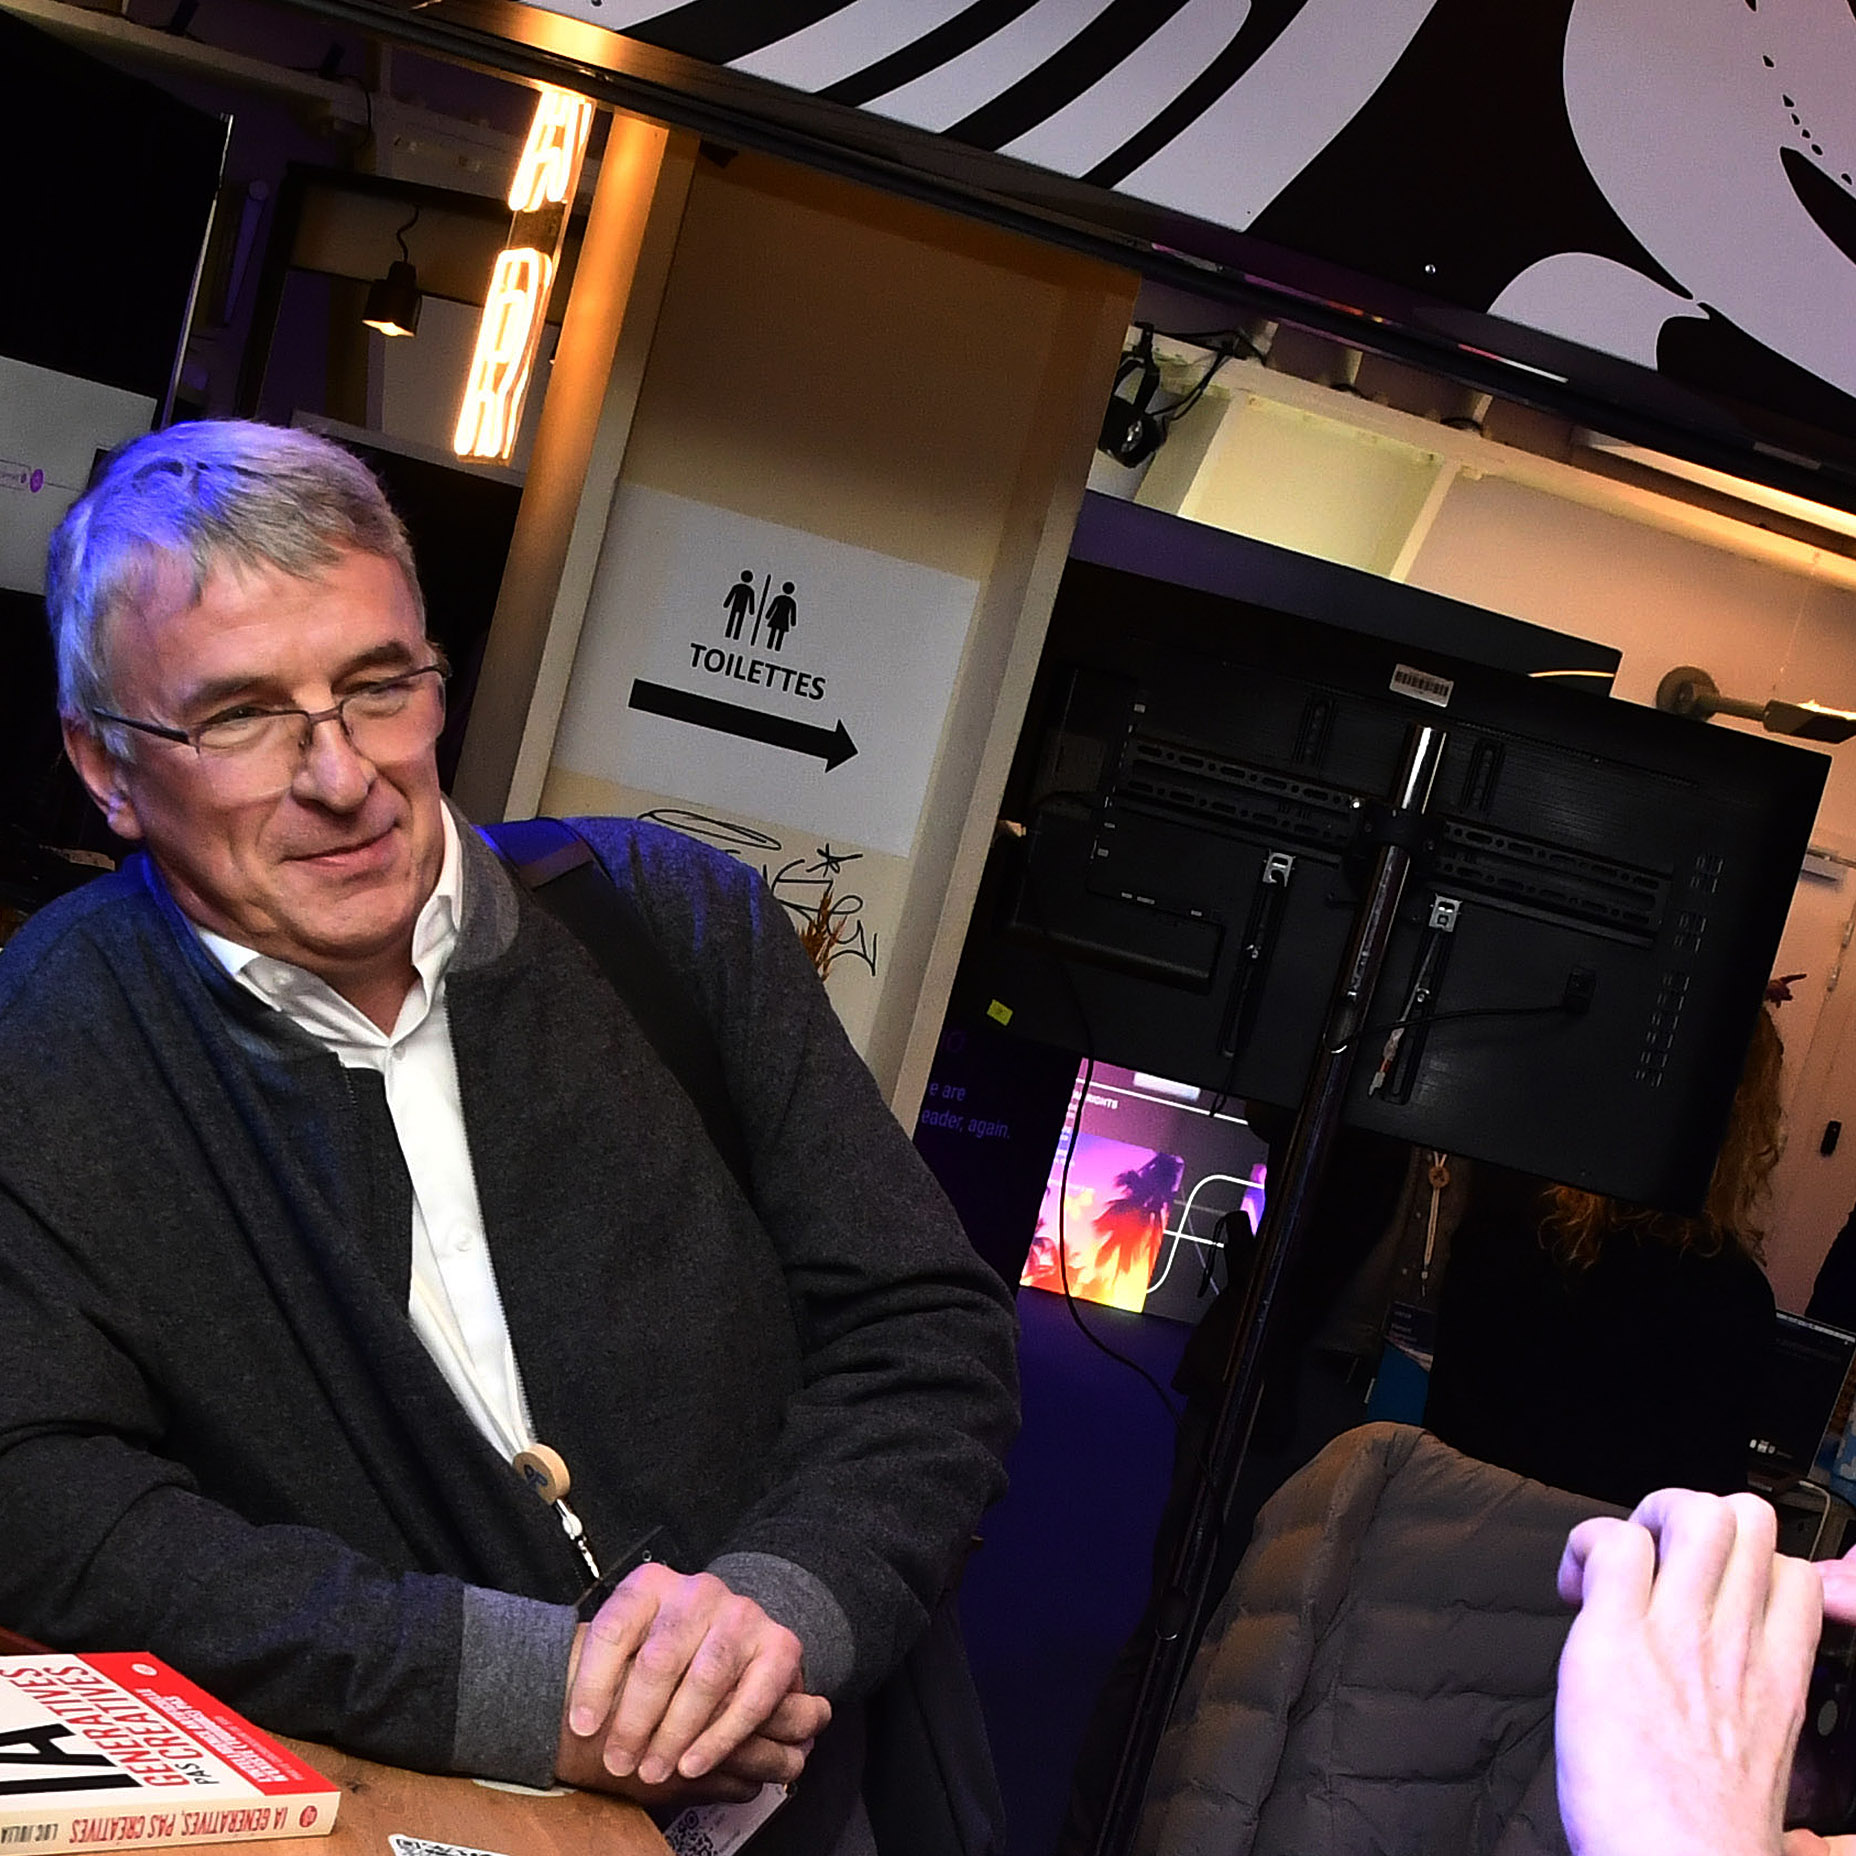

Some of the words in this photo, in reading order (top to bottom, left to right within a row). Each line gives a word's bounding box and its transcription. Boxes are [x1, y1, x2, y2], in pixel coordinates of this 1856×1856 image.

[690, 642, 826, 700] TOILETTES
[942, 1084, 967, 1102] are
[921, 1106, 965, 1133] eader,
[967, 1116, 1012, 1141] again.
[175, 1762, 220, 1786] PAS
[147, 1813, 177, 1838] PAS
[273, 1806, 289, 1830] IA
